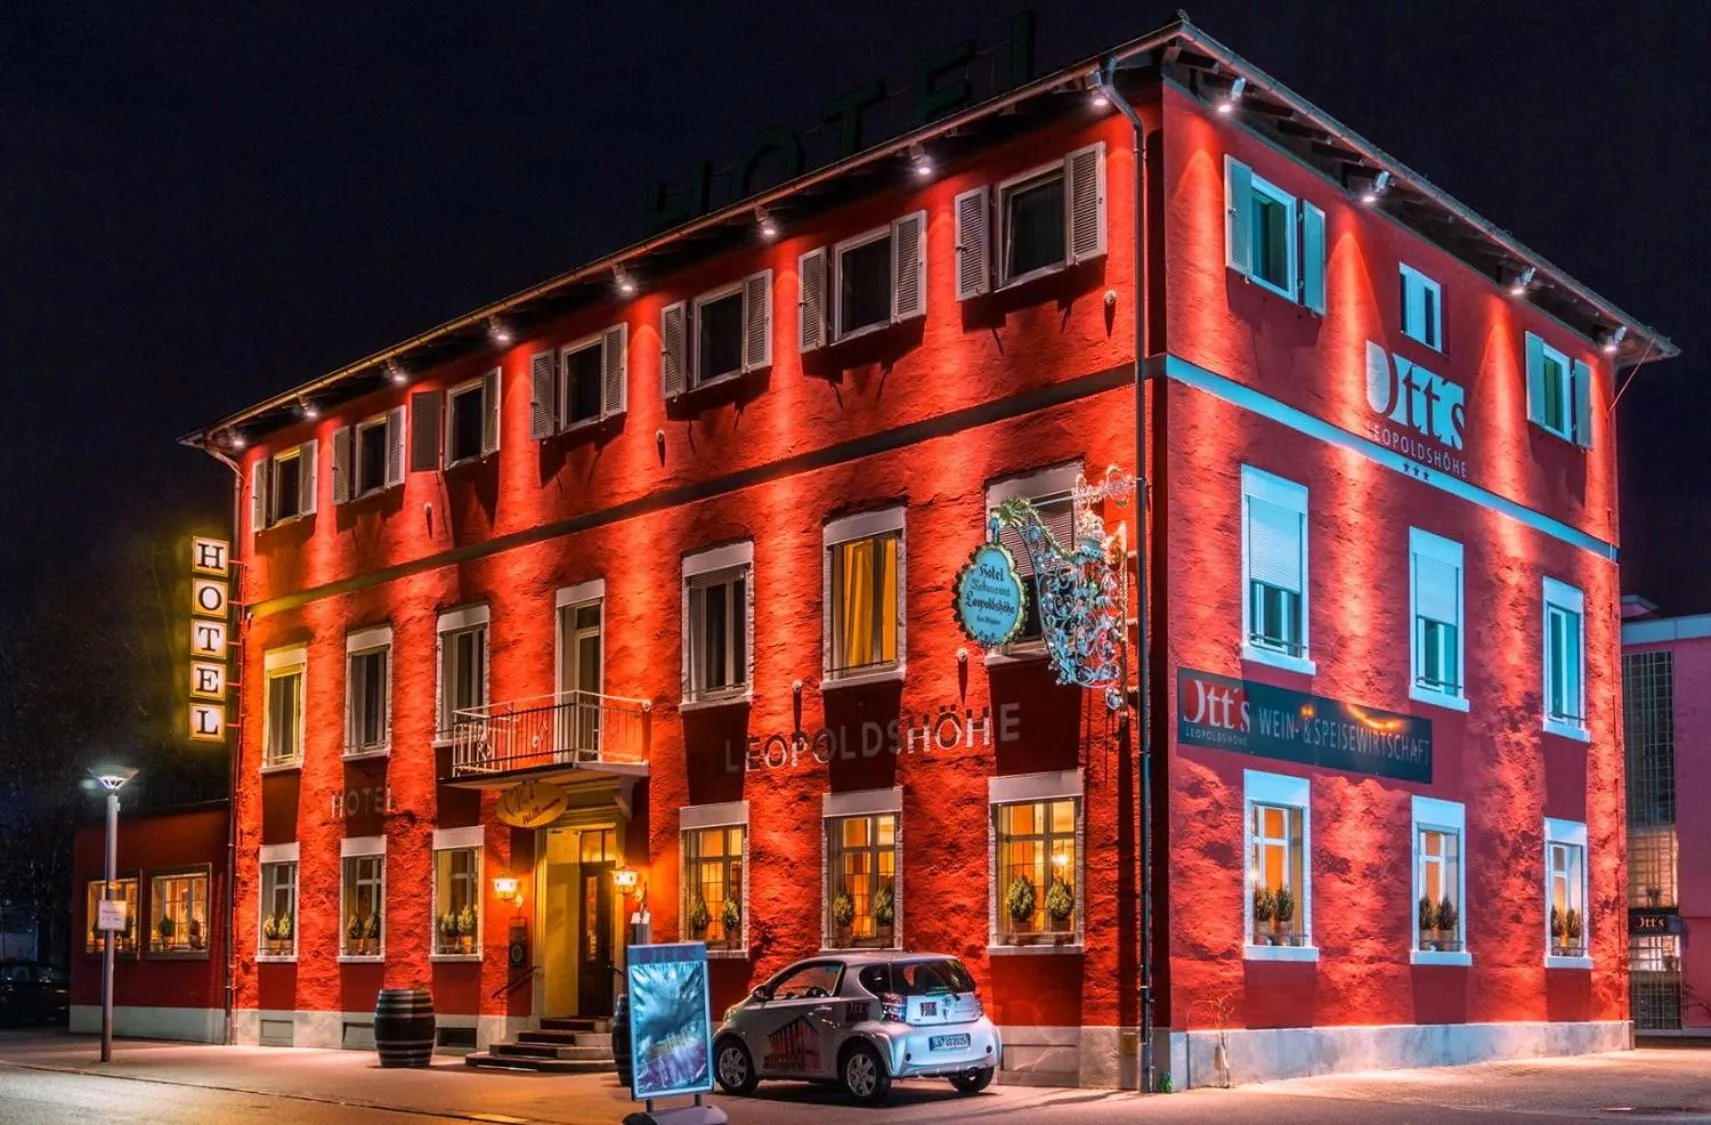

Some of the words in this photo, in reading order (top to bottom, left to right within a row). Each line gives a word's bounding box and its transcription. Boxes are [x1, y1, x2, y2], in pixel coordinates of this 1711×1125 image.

[196, 542, 225, 736] HOTEL
[725, 702, 1021, 774] LEOPOLDSHÖHE
[1258, 706, 1300, 741] WEIN-
[1303, 715, 1314, 745] &
[1315, 718, 1431, 766] SPEISEWIRTSCHAFT
[331, 785, 397, 819] HOTEL
